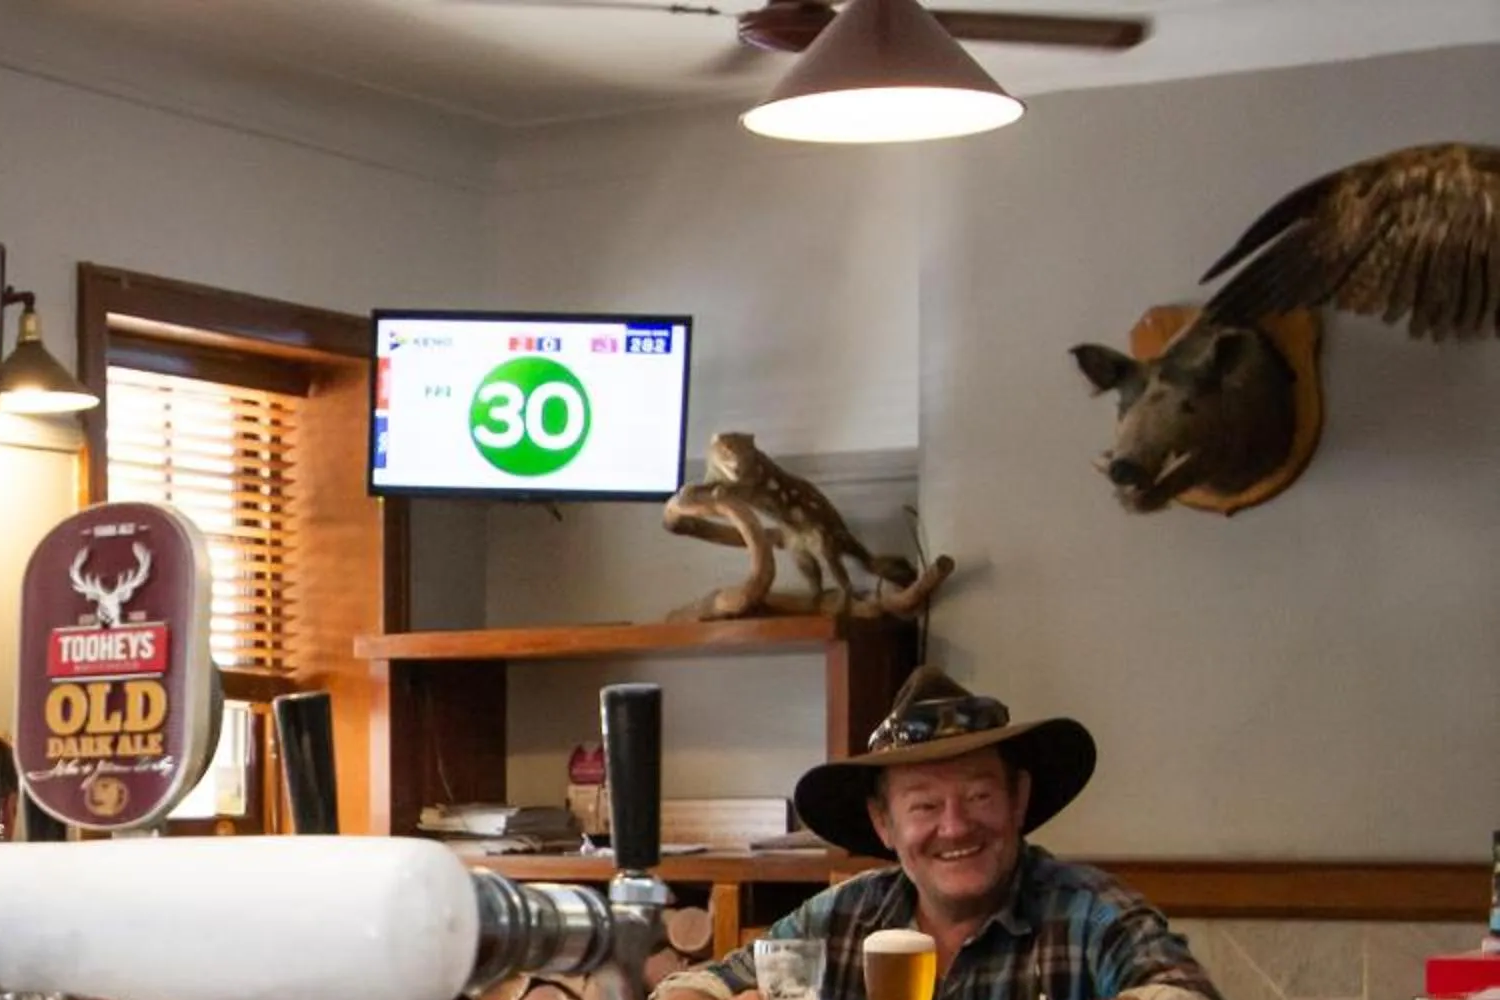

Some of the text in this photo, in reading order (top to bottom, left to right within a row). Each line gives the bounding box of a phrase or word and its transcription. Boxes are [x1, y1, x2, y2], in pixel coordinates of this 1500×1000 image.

[474, 380, 586, 451] 30
[57, 630, 155, 665] TOOHEYS
[45, 679, 167, 735] OLD
